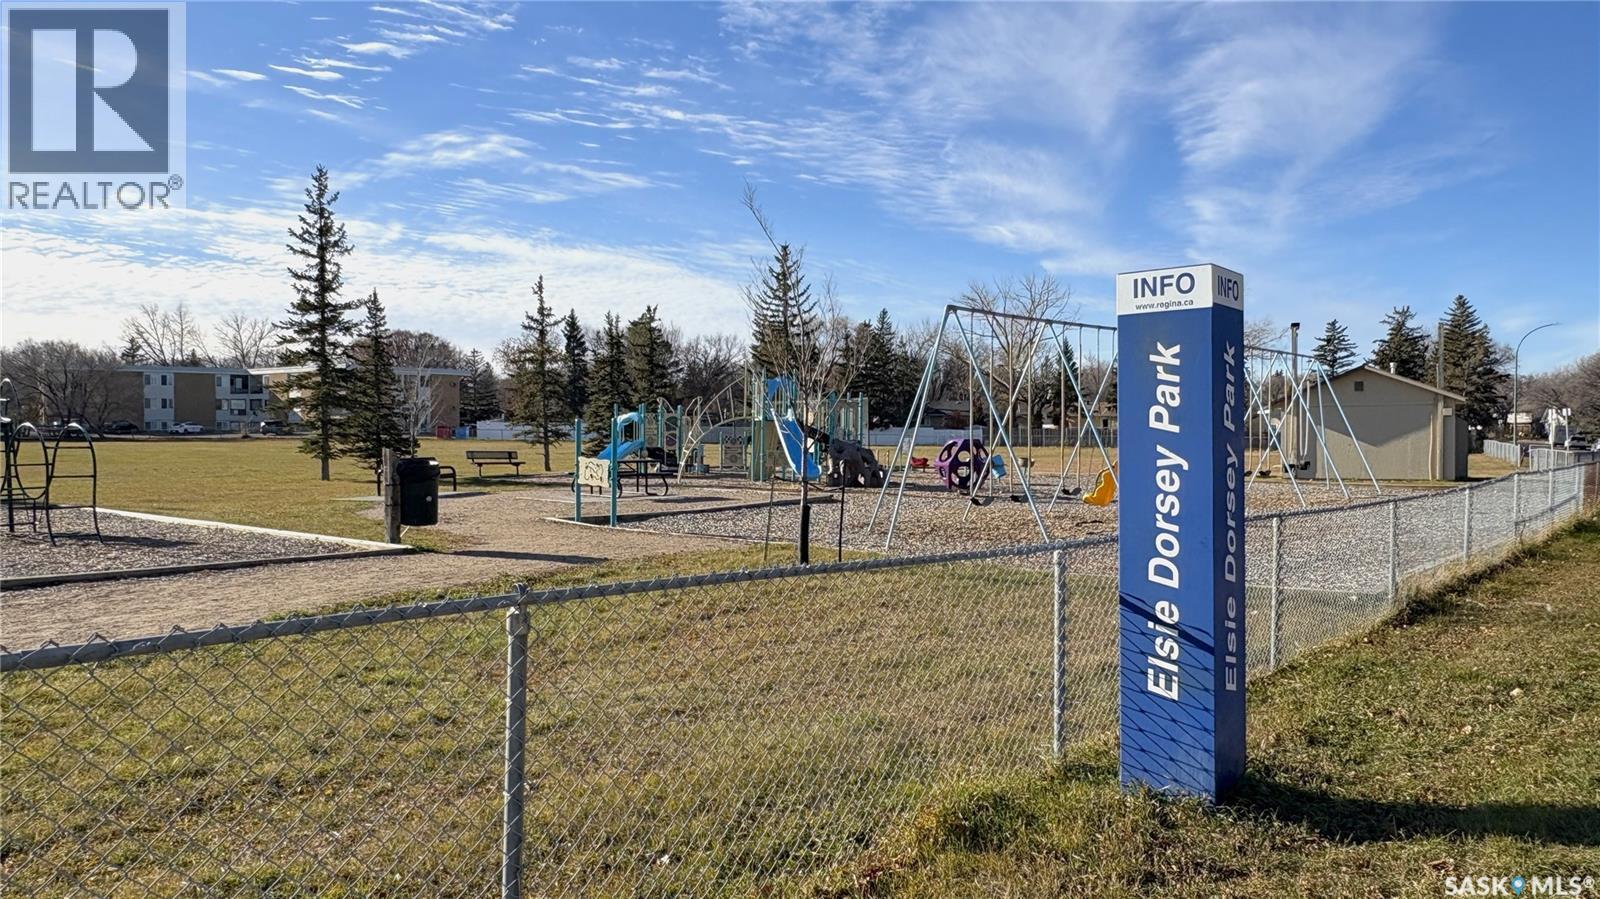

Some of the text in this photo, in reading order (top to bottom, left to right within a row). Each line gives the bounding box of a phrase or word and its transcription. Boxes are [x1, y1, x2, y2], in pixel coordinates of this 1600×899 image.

[1133, 272, 1195, 298] INFO
[1217, 275, 1240, 301] INFO
[1146, 341, 1189, 701] Elsie Dorsey Park
[1223, 341, 1239, 692] Elsie Dorsey Park
